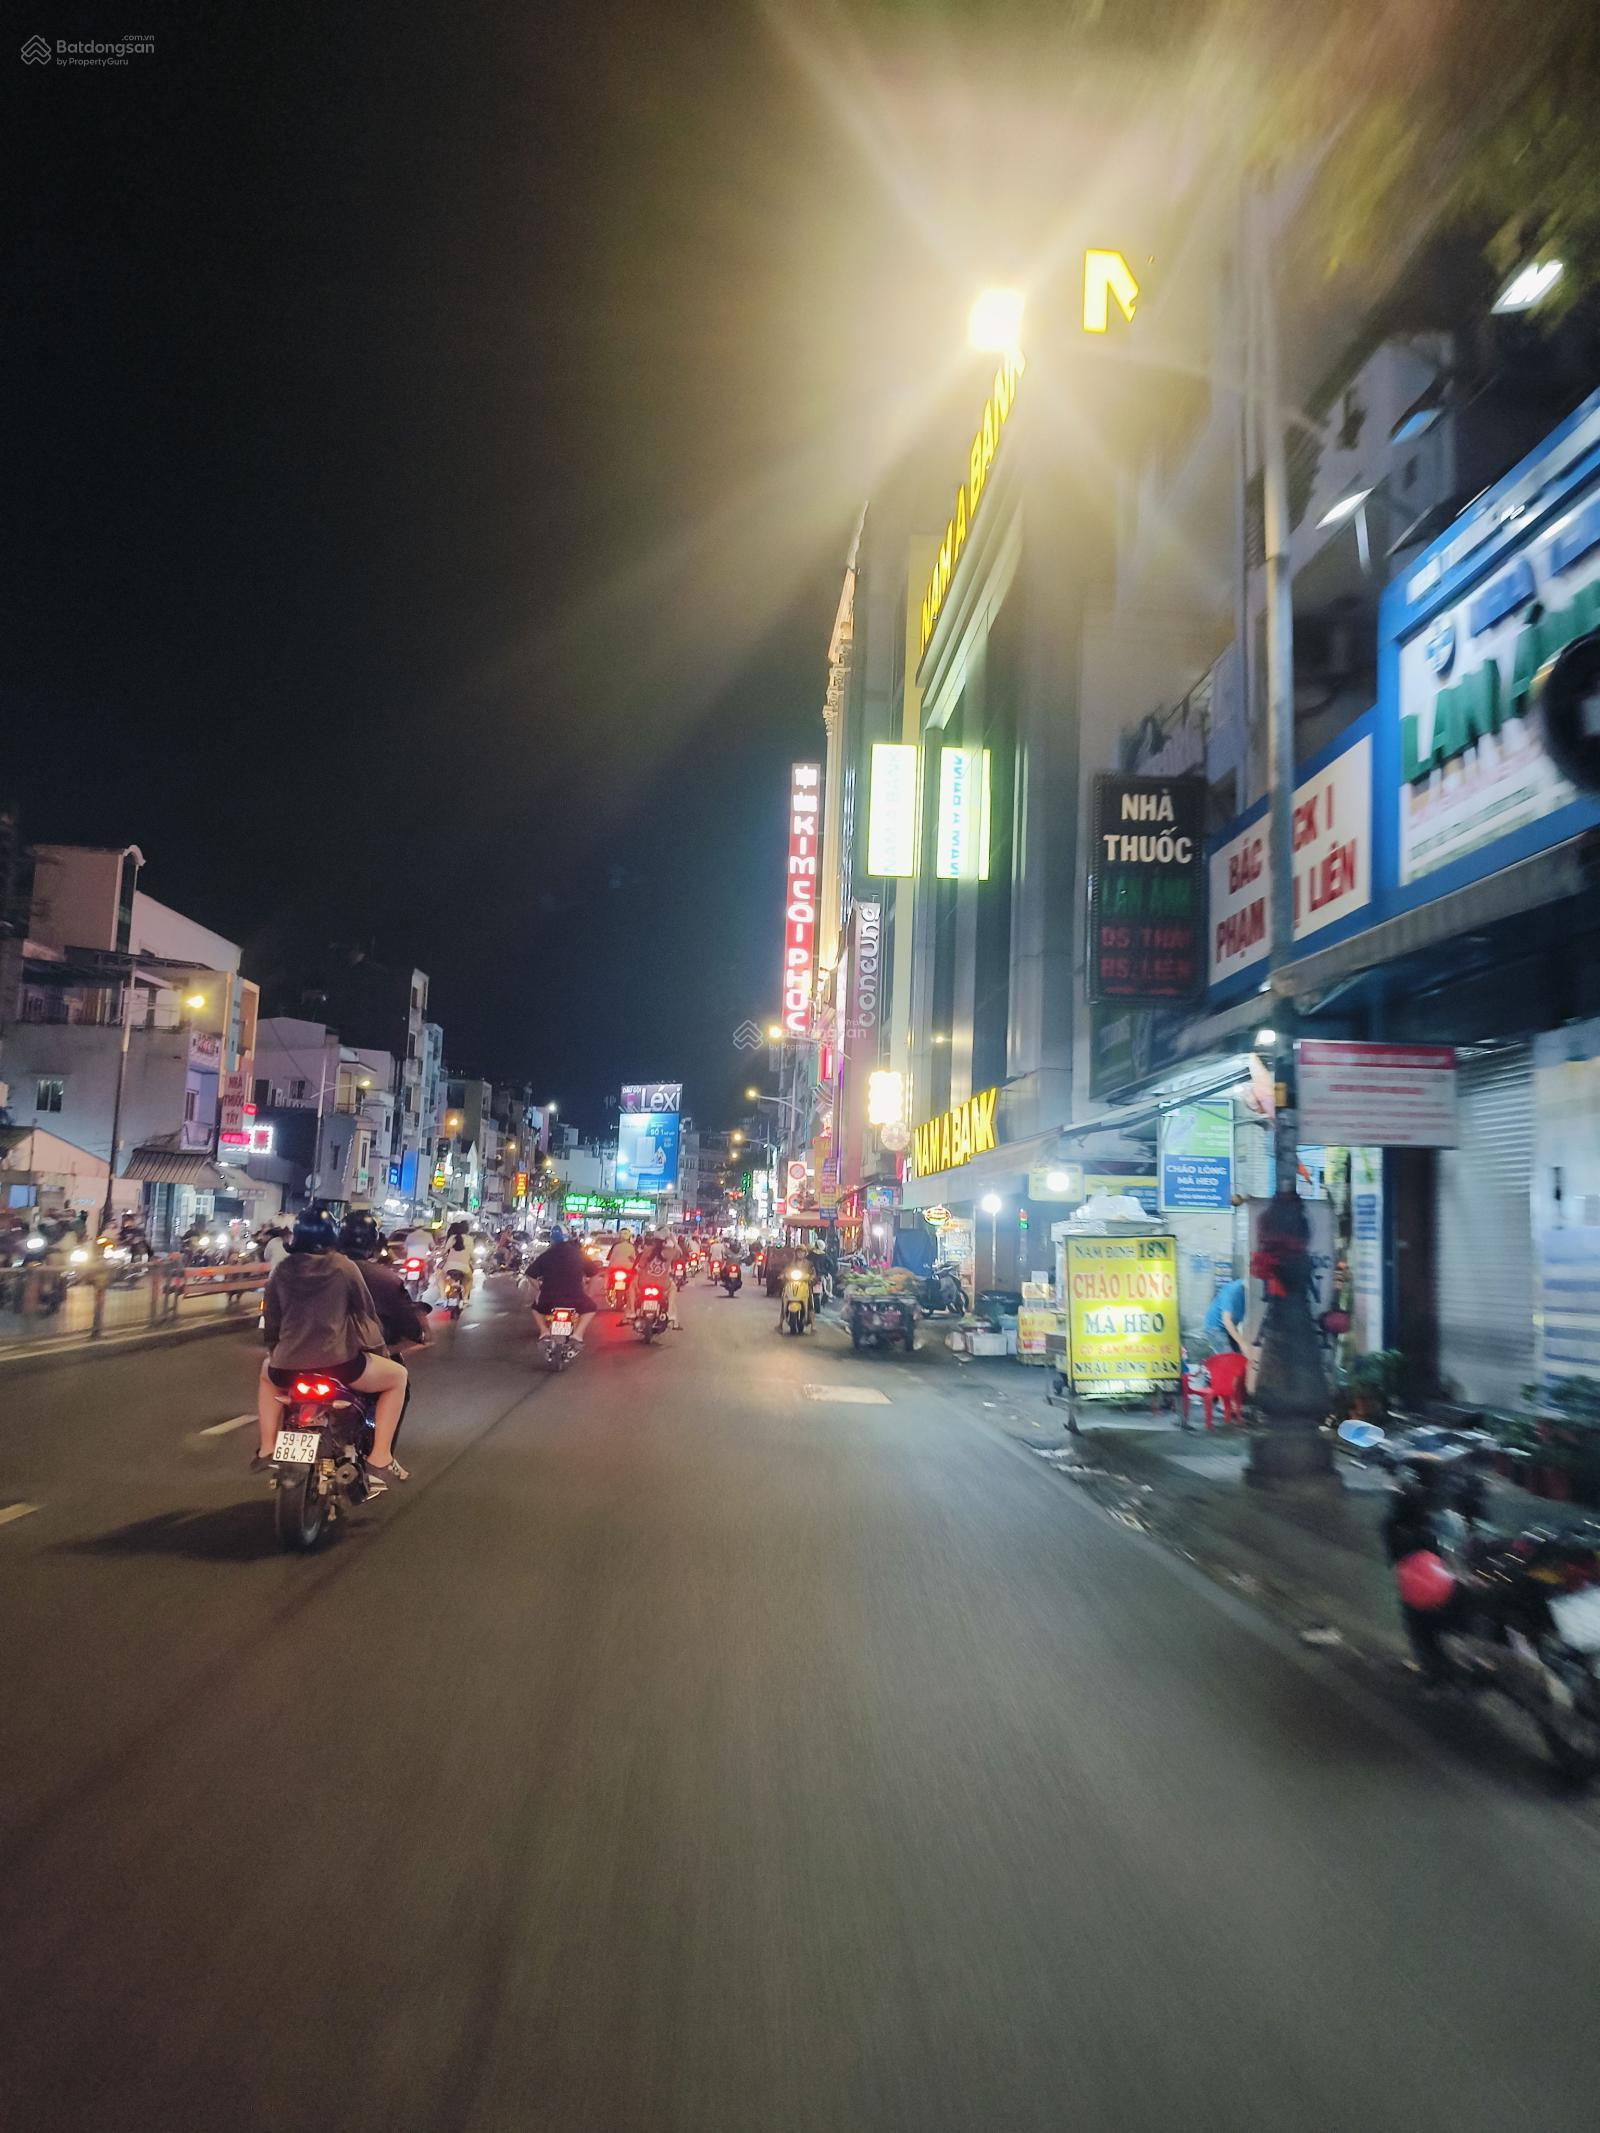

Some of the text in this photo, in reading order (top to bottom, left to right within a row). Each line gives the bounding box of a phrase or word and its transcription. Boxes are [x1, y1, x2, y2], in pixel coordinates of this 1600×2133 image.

[1121, 787, 1174, 822] NHÀ
[789, 815, 816, 875] KIM
[1103, 826, 1193, 864] THUỐC
[641, 1084, 681, 1112] Léxi
[914, 1088, 997, 1177] NAM A BANK
[1124, 1312, 1165, 1334] HEO
[275, 1446, 315, 1462] 684.79
[282, 1432, 314, 1448] 59-P2
